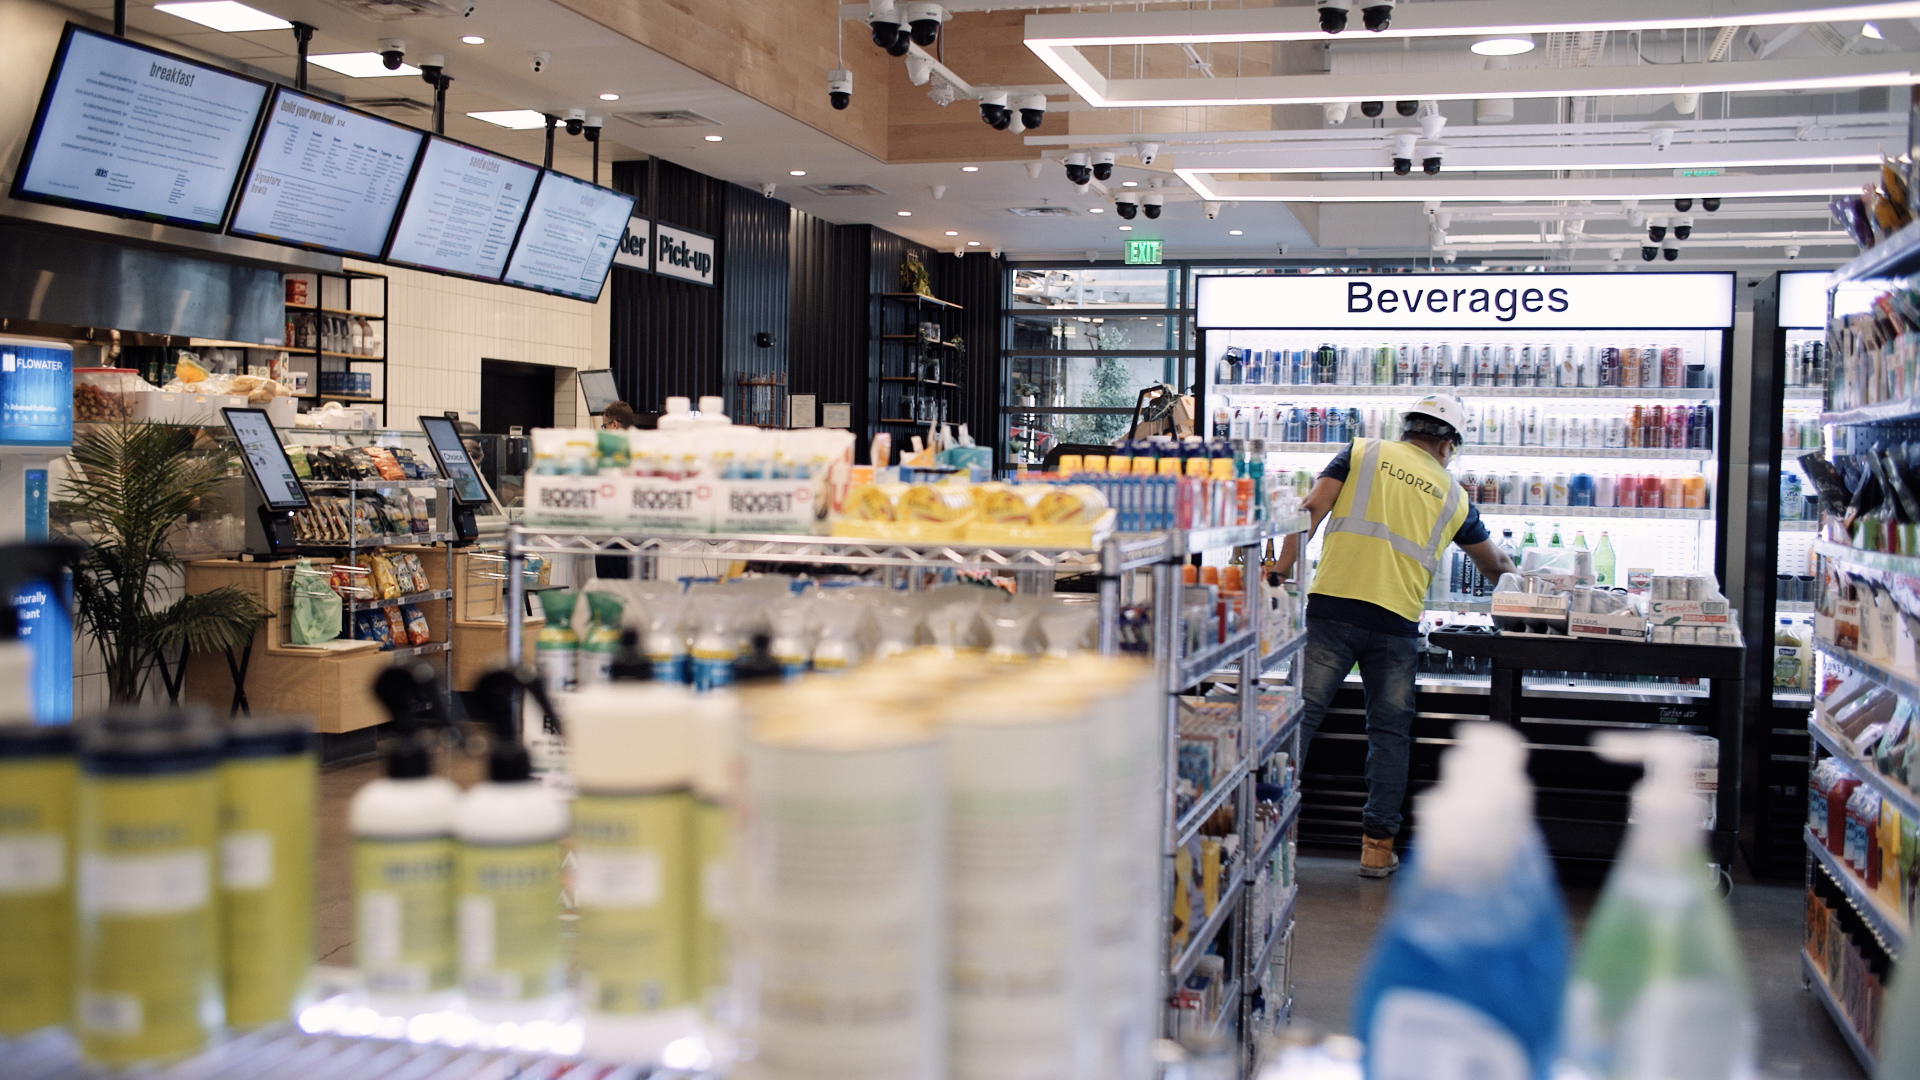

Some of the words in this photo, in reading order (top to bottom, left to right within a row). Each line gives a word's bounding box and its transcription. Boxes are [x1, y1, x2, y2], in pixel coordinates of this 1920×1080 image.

[149, 61, 196, 88] breakfast
[281, 99, 296, 115] build
[294, 103, 310, 117] your
[309, 109, 322, 121] own
[321, 111, 336, 126] bowl
[469, 156, 501, 173] sandwiches
[254, 172, 281, 187] signature
[620, 227, 647, 257] der
[1130, 242, 1160, 263] EXIT
[659, 234, 711, 278] Pick-up
[1347, 282, 1570, 321] Beverages
[17, 358, 63, 371] FLOWATER
[1380, 461, 1433, 494] FLOORZ
[1572, 617, 1598, 626] CELSIUS
[1658, 706, 1682, 717] Turbo
